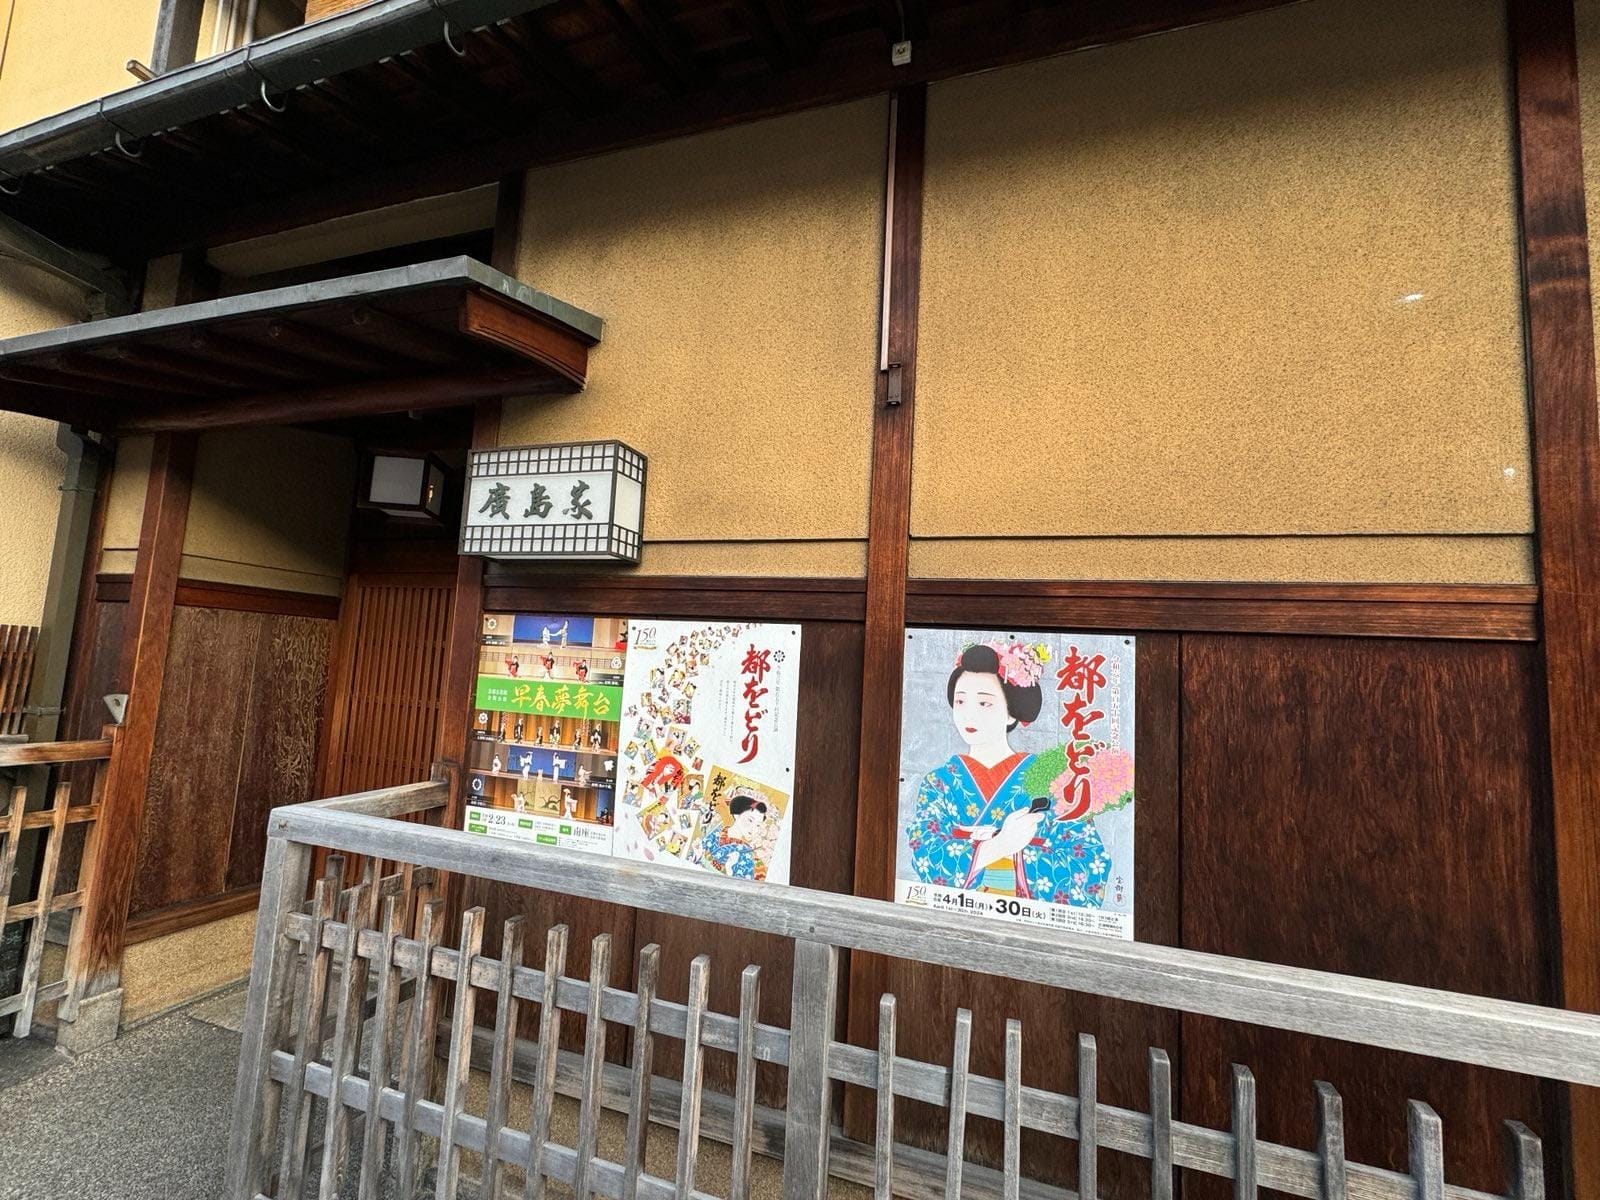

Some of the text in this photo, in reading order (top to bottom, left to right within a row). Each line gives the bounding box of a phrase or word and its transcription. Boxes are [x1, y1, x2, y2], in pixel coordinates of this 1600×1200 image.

[478, 479, 594, 521] 廣島家
[635, 627, 657, 645] 150
[511, 684, 611, 724] 早春夢舞台
[737, 643, 772, 764] 都をどり
[1055, 645, 1108, 822] 都をどり
[701, 772, 726, 824] 都をどり
[905, 886, 929, 900] 150
